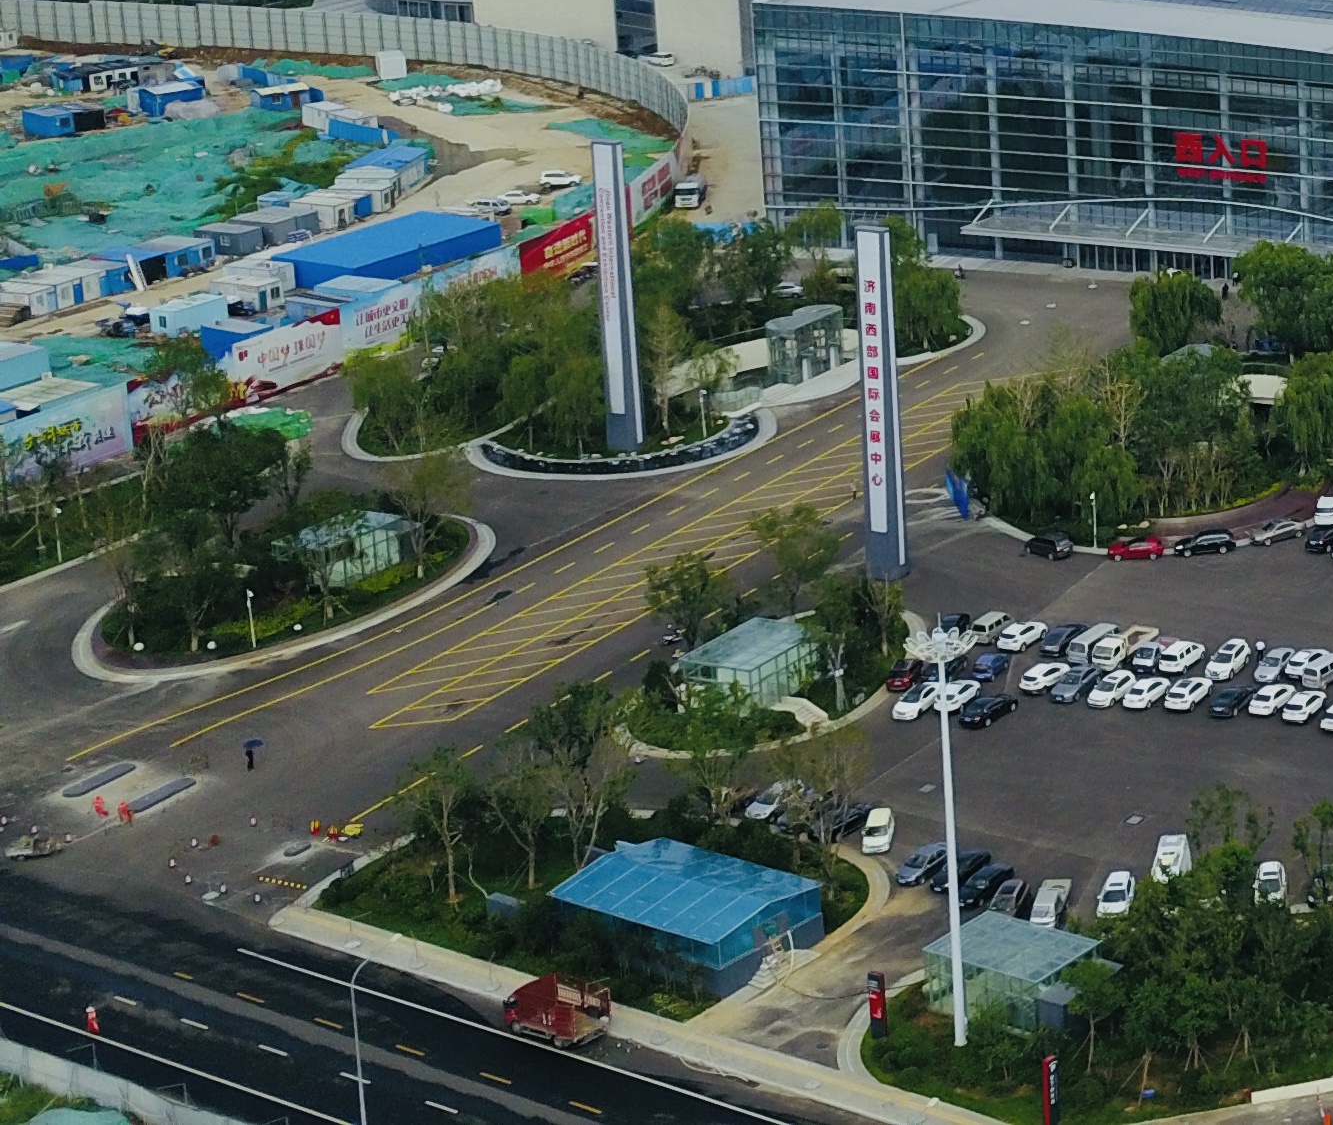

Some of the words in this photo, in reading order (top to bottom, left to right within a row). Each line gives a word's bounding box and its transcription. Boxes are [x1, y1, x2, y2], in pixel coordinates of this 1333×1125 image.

[1174, 132, 1267, 169] 西入口
[864, 279, 883, 487] 济南西部国际会展中心
